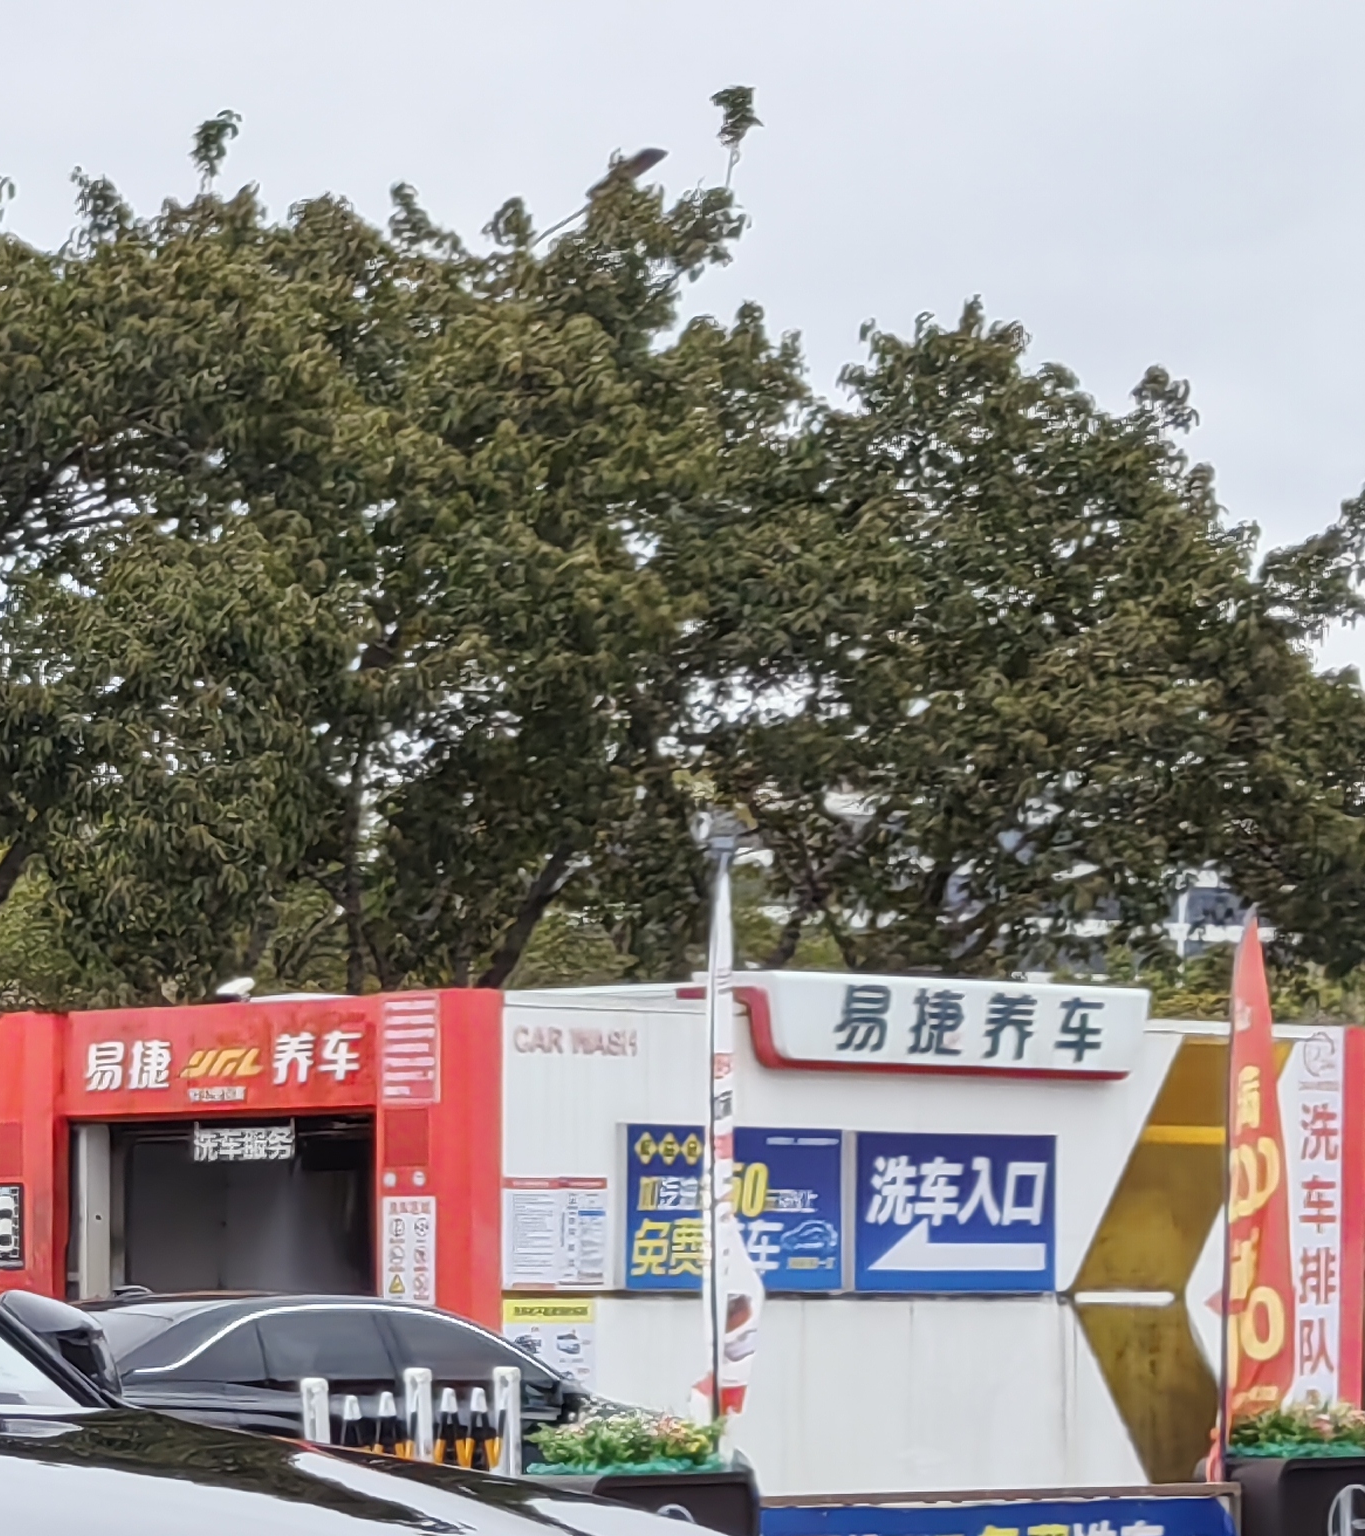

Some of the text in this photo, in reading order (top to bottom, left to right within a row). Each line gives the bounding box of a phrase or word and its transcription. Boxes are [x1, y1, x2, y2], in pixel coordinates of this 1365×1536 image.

[513, 1026, 639, 1057] CAR WASH
[833, 984, 1105, 1063] 易捷养车
[84, 1040, 171, 1092] 易捷
[272, 1031, 364, 1086] 养车
[193, 1127, 295, 1162] 洗车服务
[865, 1155, 1048, 1227] 洗车入口
[630, 1217, 784, 1276] 免费车
[1298, 1102, 1341, 1405] 洗车排队
